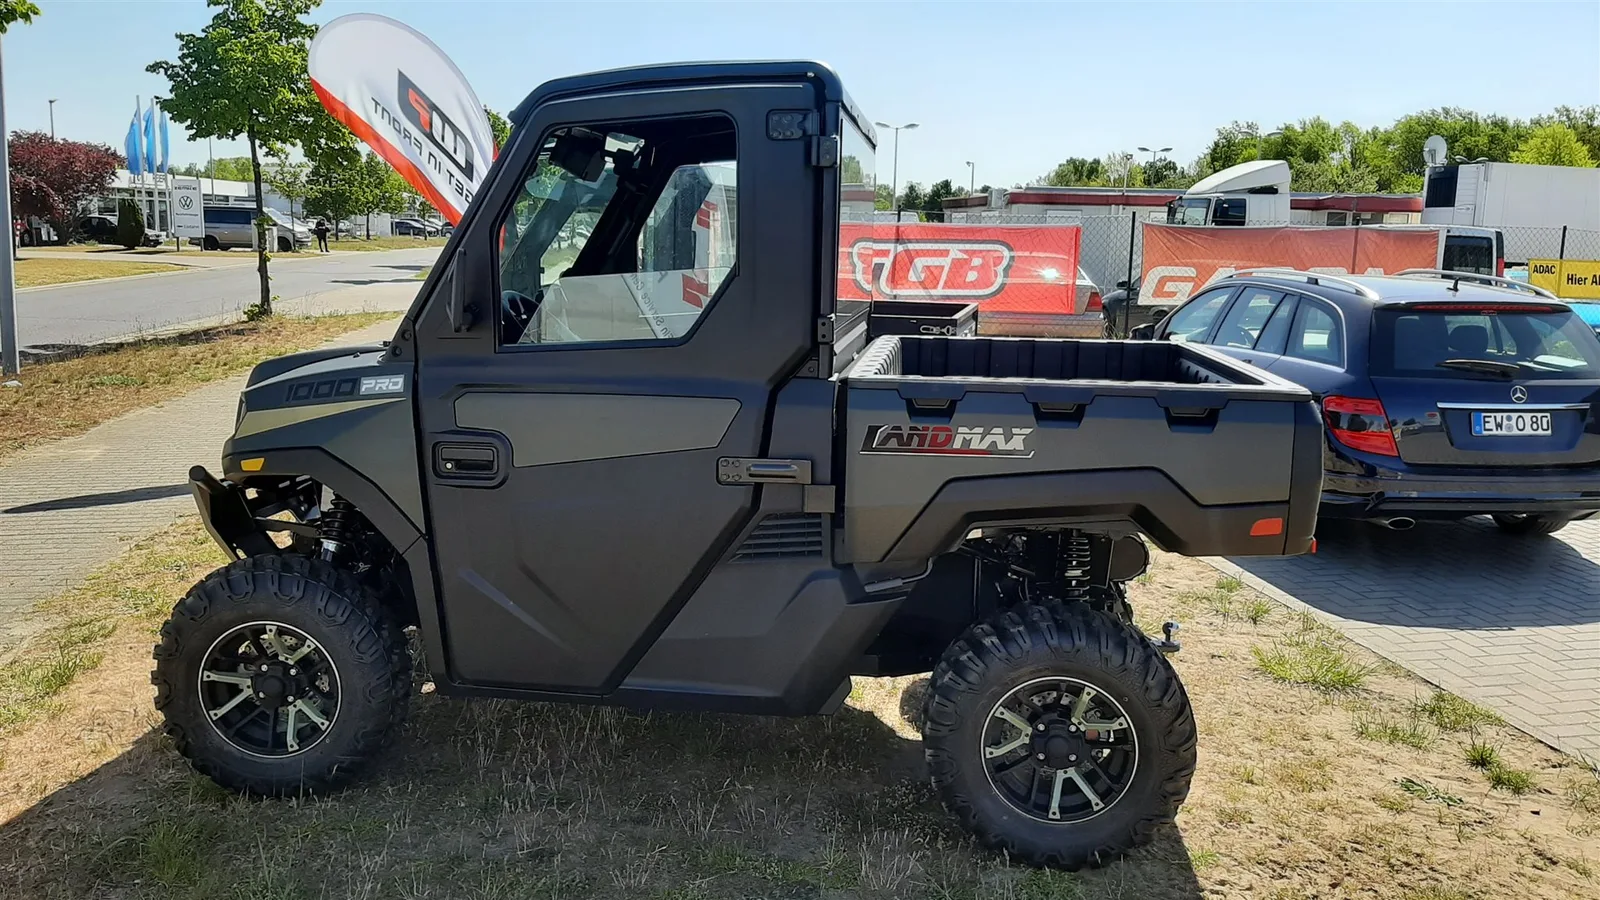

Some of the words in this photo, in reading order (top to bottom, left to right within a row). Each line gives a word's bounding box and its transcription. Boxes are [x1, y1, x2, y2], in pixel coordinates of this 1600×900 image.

[852, 241, 1011, 296] TGB
[1532, 264, 1556, 275] ADAC
[1566, 273, 1589, 286] Hier
[1590, 274, 1600, 286] A
[285, 378, 359, 402] 1000
[361, 376, 404, 393] PRO
[1483, 415, 1504, 432] EW
